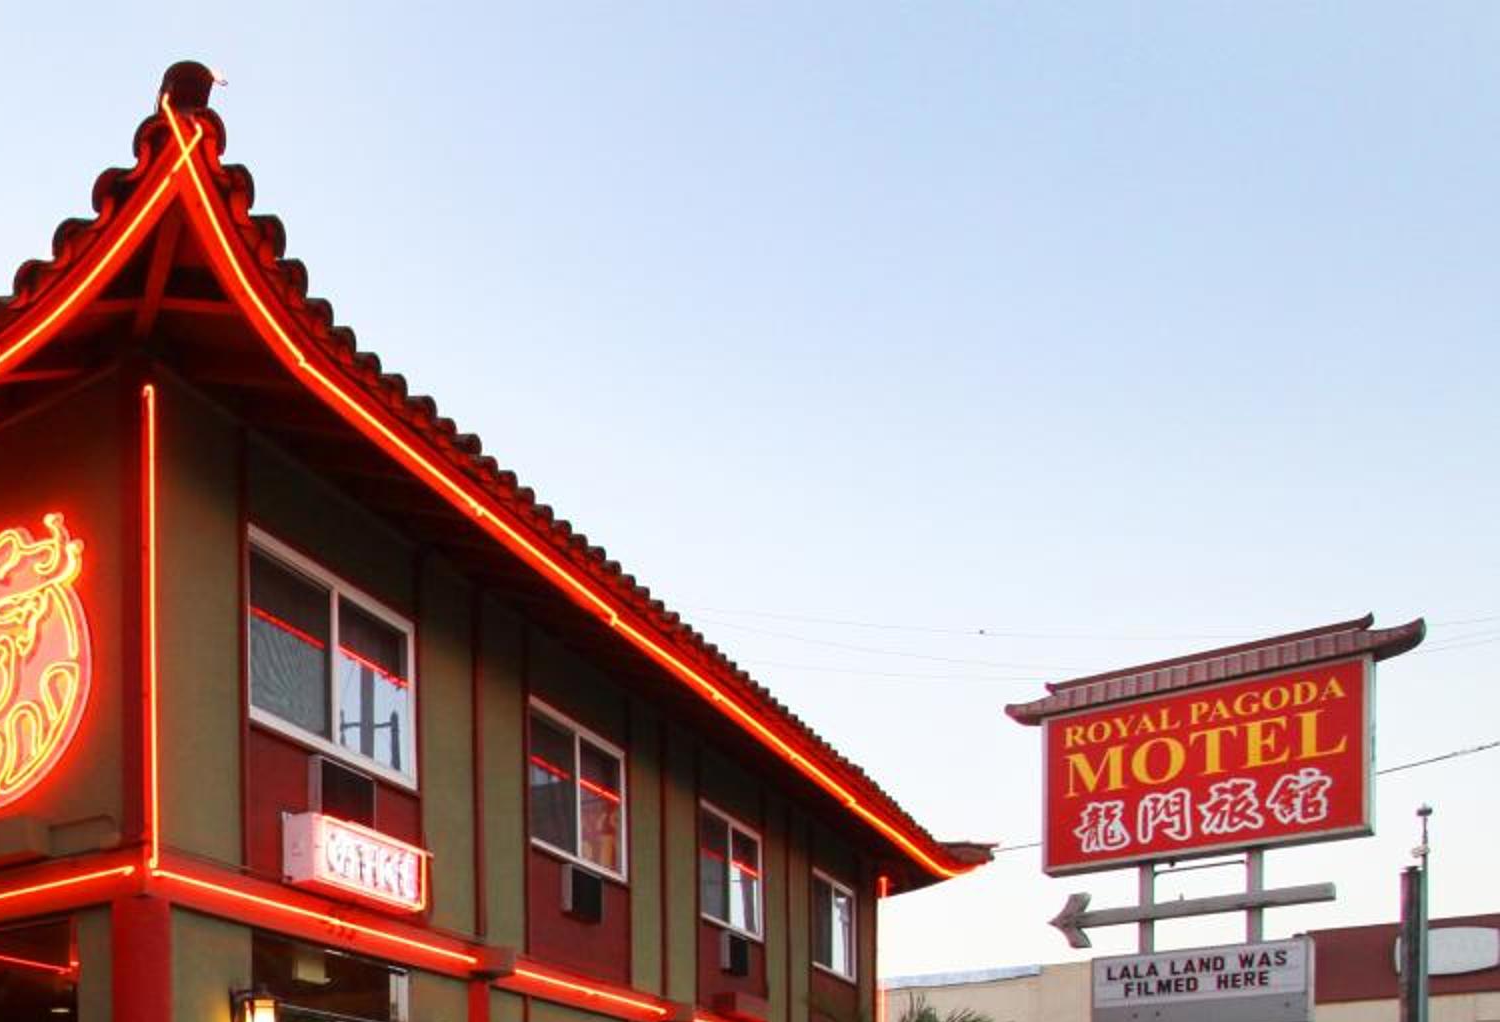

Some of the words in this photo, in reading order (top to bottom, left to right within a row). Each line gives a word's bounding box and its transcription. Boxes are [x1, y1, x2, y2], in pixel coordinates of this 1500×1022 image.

[1065, 708, 1181, 749] ROYAL
[1190, 677, 1345, 725] PAGODA
[1065, 710, 1348, 798] MOTEL
[1106, 962, 1160, 982] LALA
[1169, 955, 1225, 976] LAND
[1238, 950, 1288, 970] WAS
[1123, 976, 1199, 998] FILMED
[1216, 970, 1270, 991] HERE
